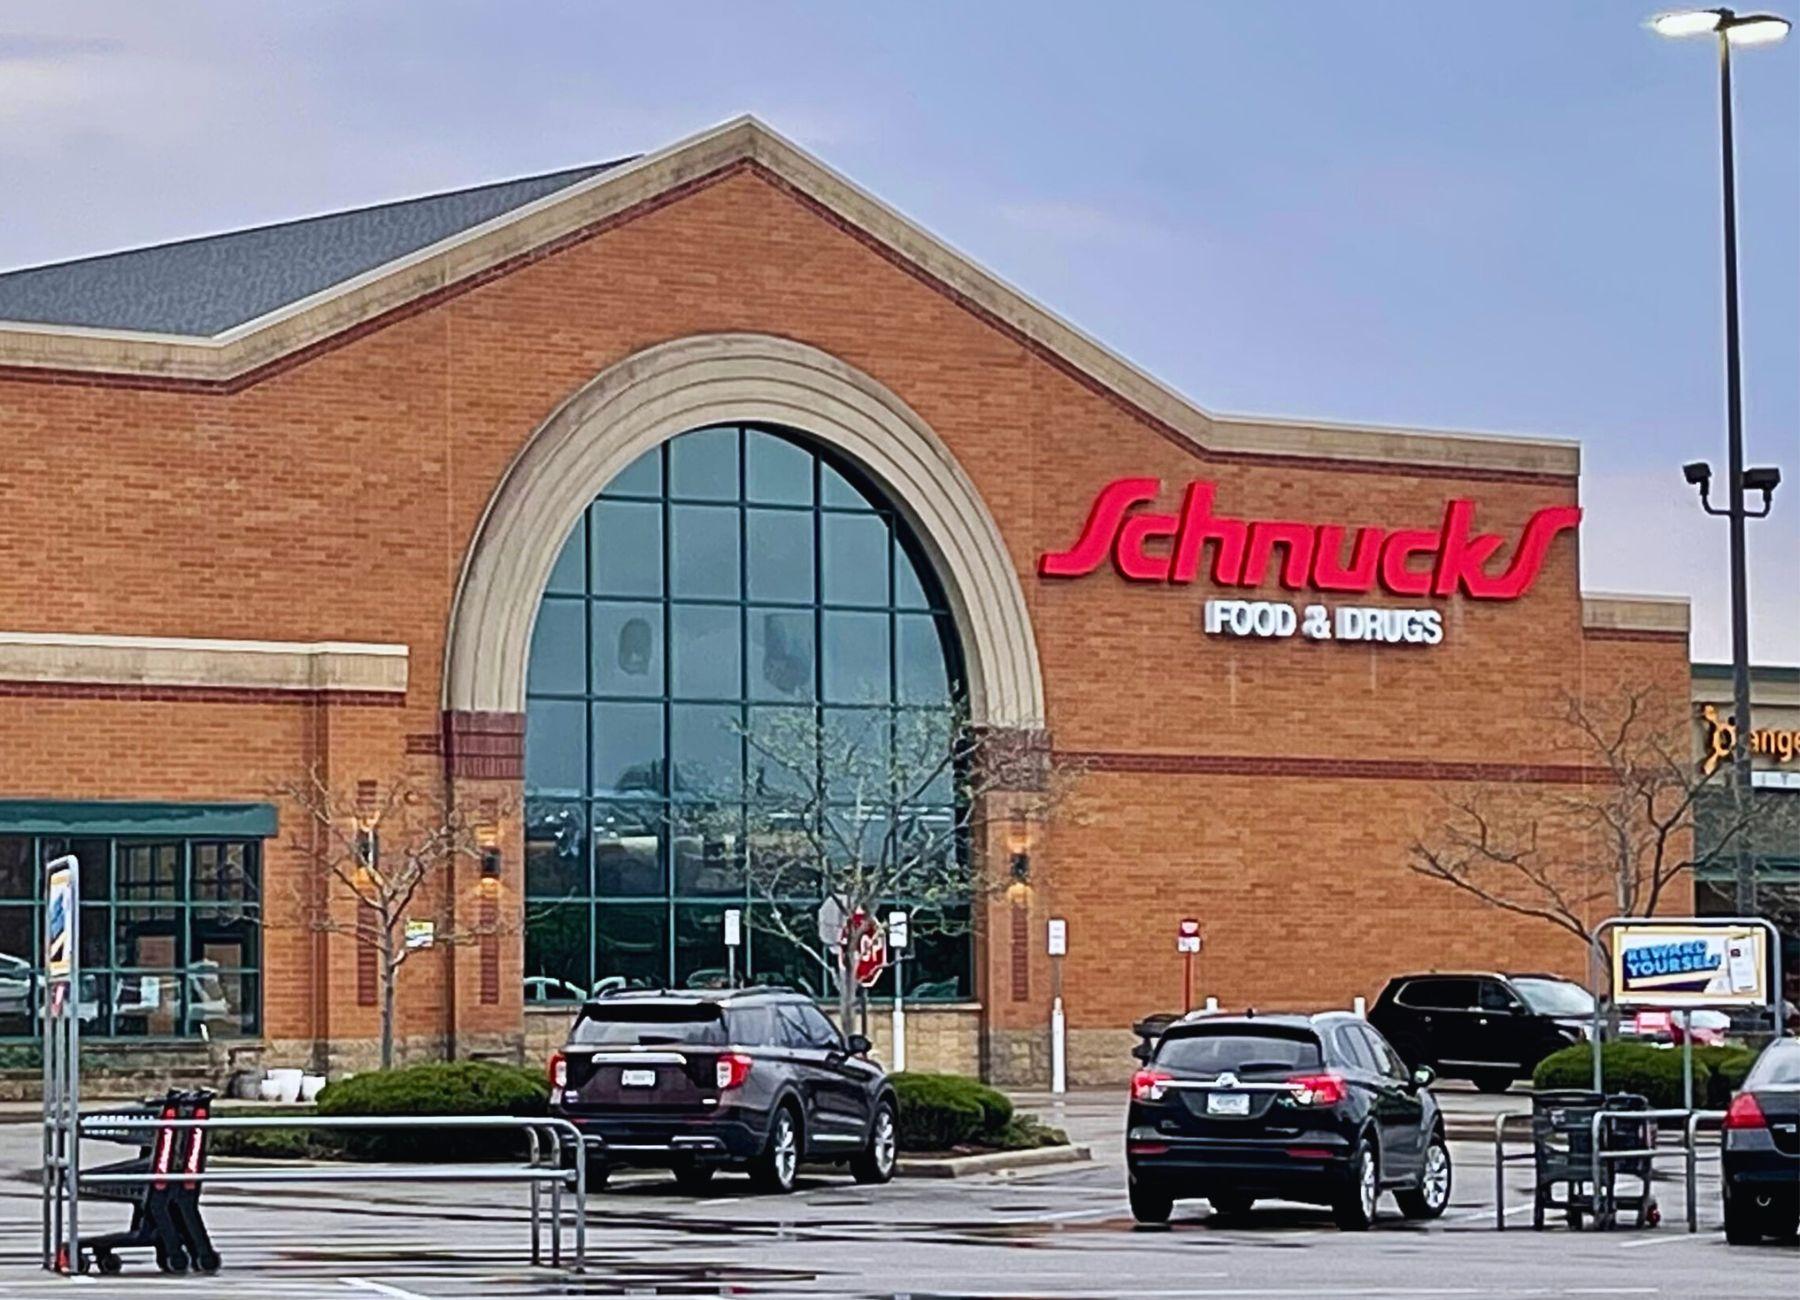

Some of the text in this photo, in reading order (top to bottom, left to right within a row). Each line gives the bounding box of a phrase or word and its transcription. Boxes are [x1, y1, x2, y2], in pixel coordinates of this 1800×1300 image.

[1204, 599, 1443, 646] FOOD & DRUGS
[1626, 939, 1709, 963] REWARD
[1626, 953, 1722, 977] YOURSELF
